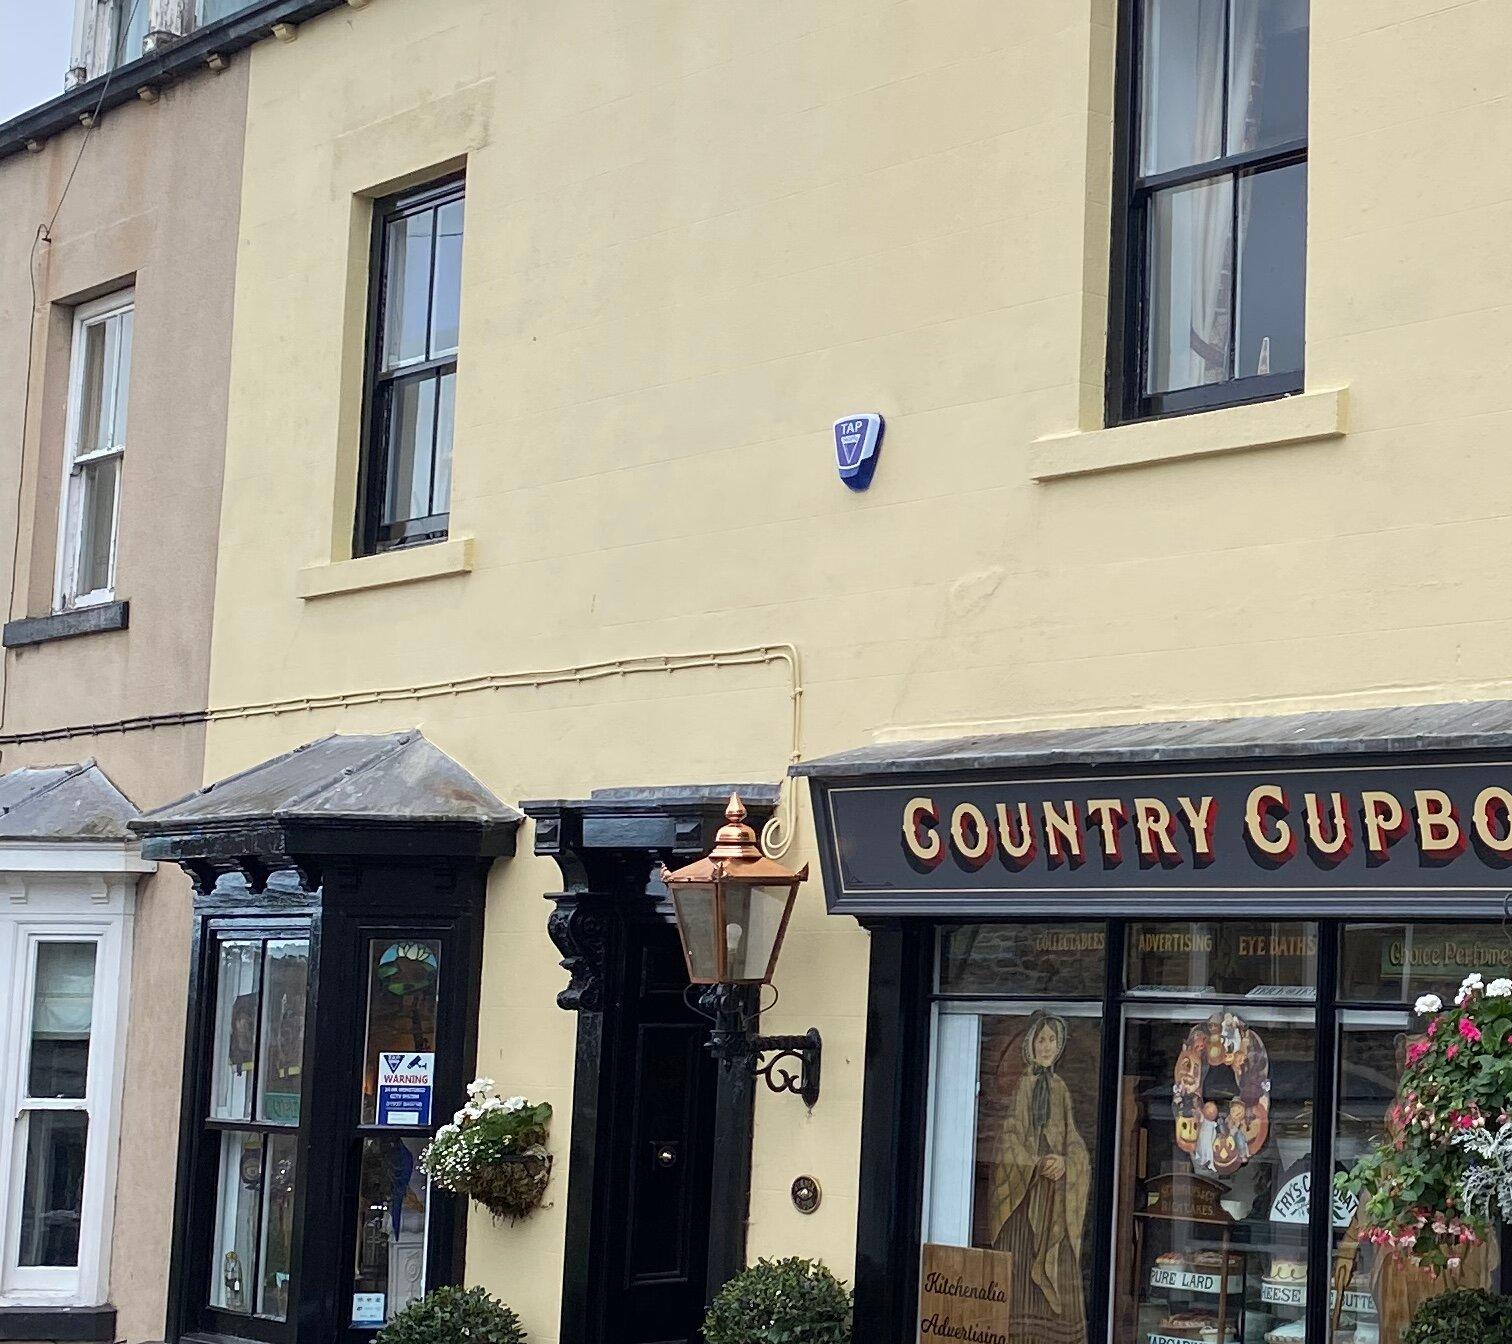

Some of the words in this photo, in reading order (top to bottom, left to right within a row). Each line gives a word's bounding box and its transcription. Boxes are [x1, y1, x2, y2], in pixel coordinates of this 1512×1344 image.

[841, 420, 863, 434] TAP
[902, 794, 1218, 872] COUNTRY
[1137, 933, 1214, 953] ADVERTISING
[1237, 935, 1266, 956] EYE
[1269, 935, 1317, 956] BATHS
[384, 1074, 428, 1084] WARNING
[924, 1271, 1008, 1304] Kitchenalia
[1181, 1273, 1214, 1290] LARD
